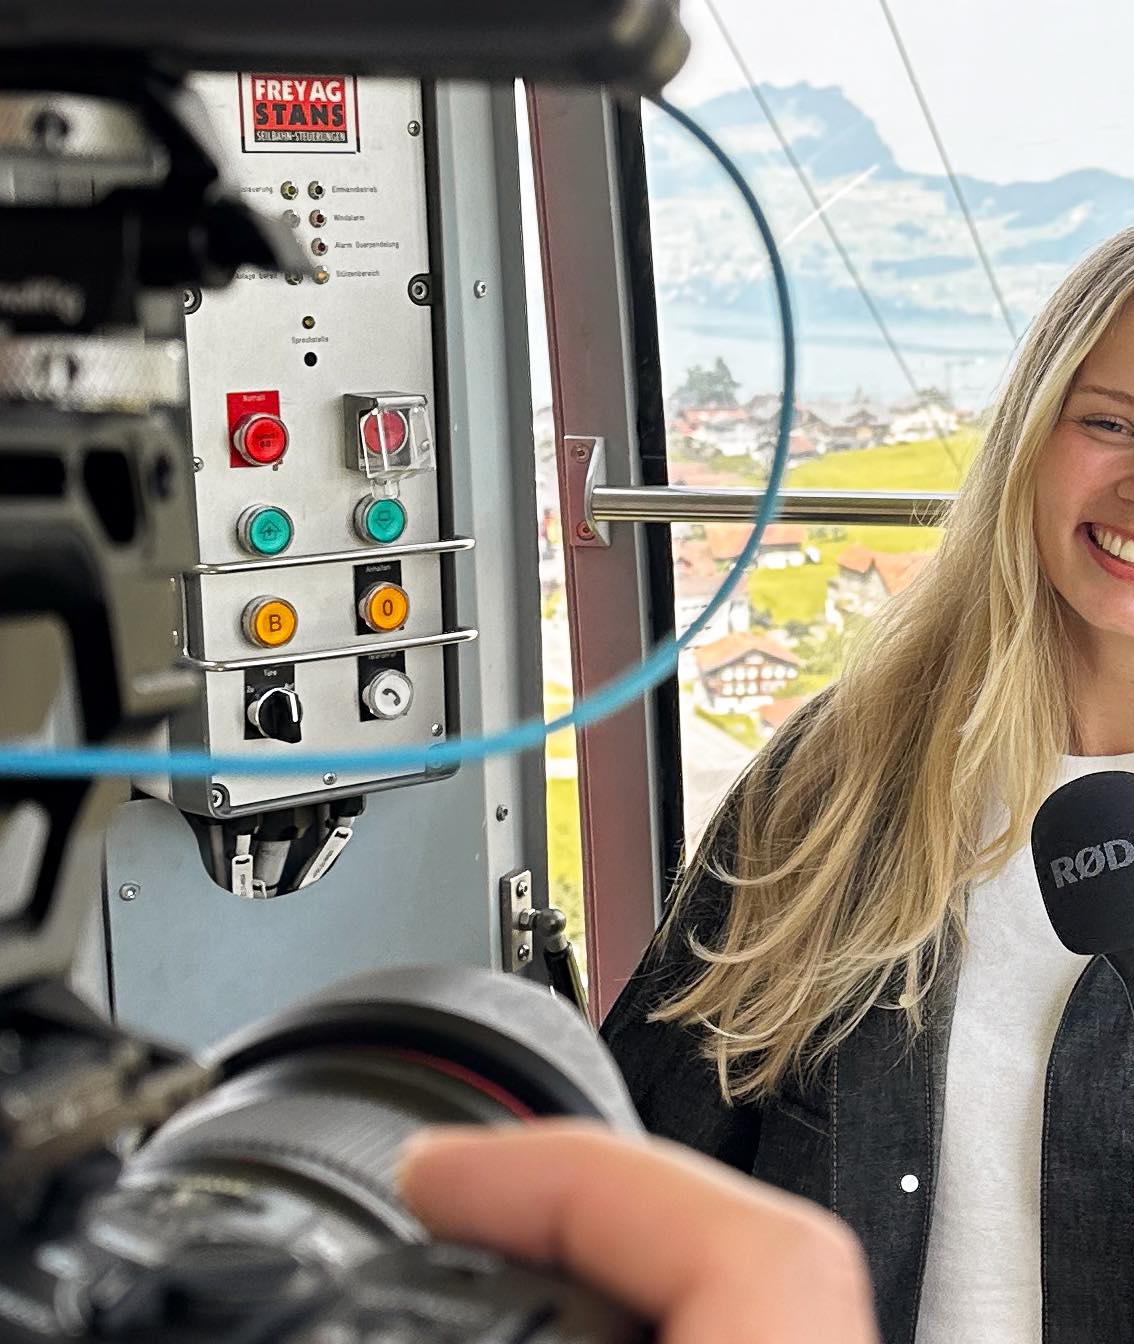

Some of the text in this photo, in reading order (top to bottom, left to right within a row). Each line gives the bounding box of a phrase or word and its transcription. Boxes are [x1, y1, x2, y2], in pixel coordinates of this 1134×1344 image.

[255, 79, 342, 103] FREY AG
[256, 103, 343, 127] STANS
[256, 131, 346, 141] SEILBAHN-STEUERUNGEN
[269, 614, 282, 633] B
